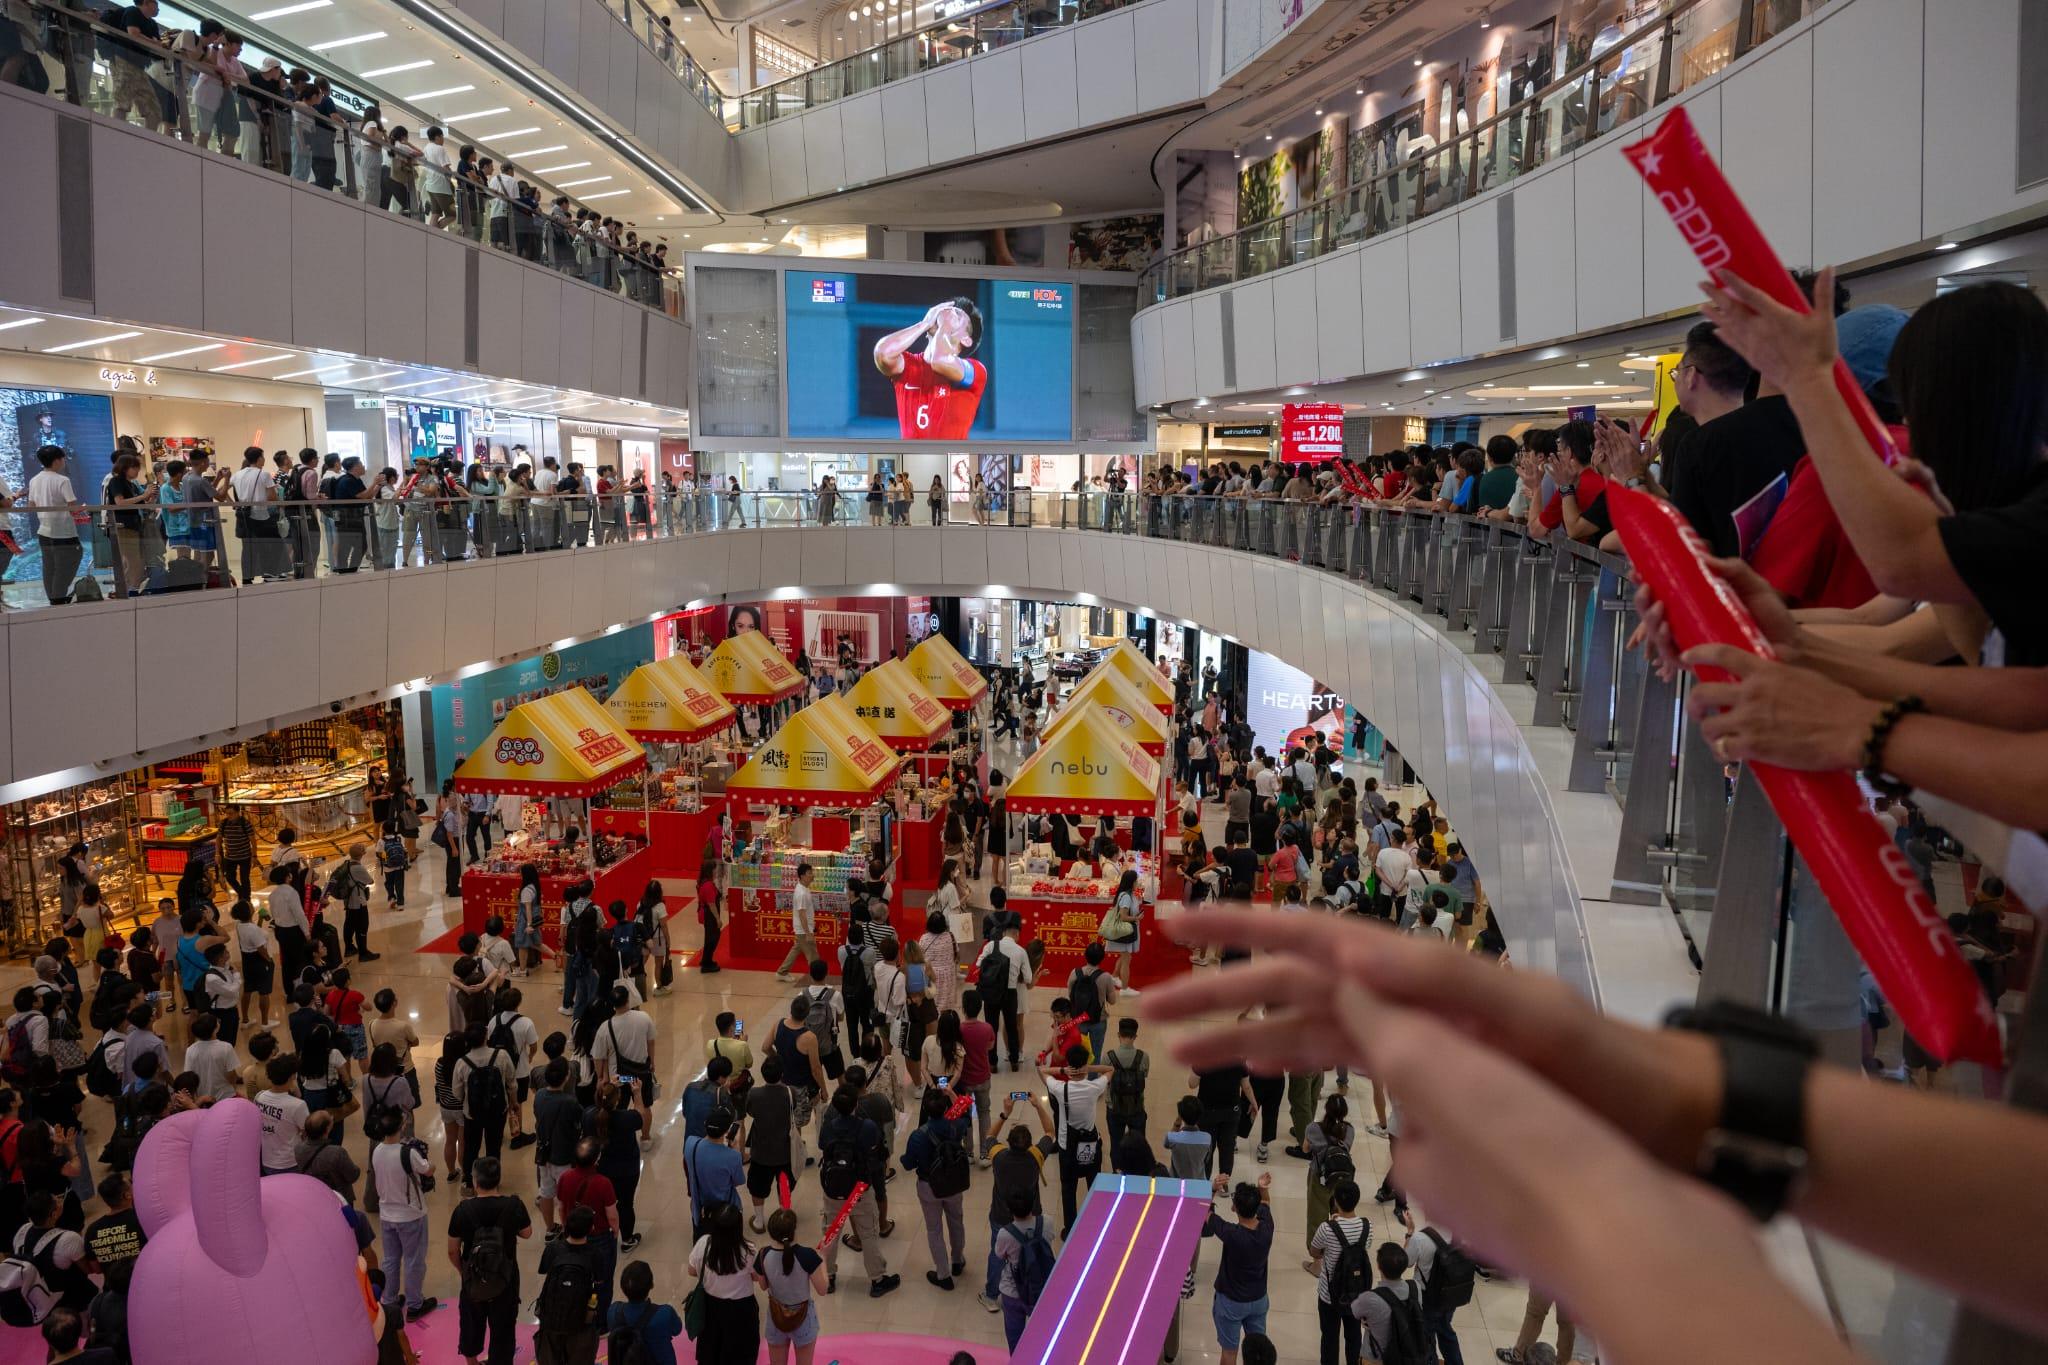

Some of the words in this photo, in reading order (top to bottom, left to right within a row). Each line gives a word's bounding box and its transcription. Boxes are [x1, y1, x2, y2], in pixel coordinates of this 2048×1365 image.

[1658, 187, 1731, 271] apm
[916, 405, 930, 430] 6
[1308, 425, 1341, 442] 1,200
[519, 671, 538, 685] apm
[610, 700, 668, 710] BETHLEHEM
[502, 740, 535, 751] HEY
[1051, 756, 1108, 775] nebu
[90, 1231, 138, 1248] TREADMILLS
[97, 1224, 127, 1238] BEFORE
